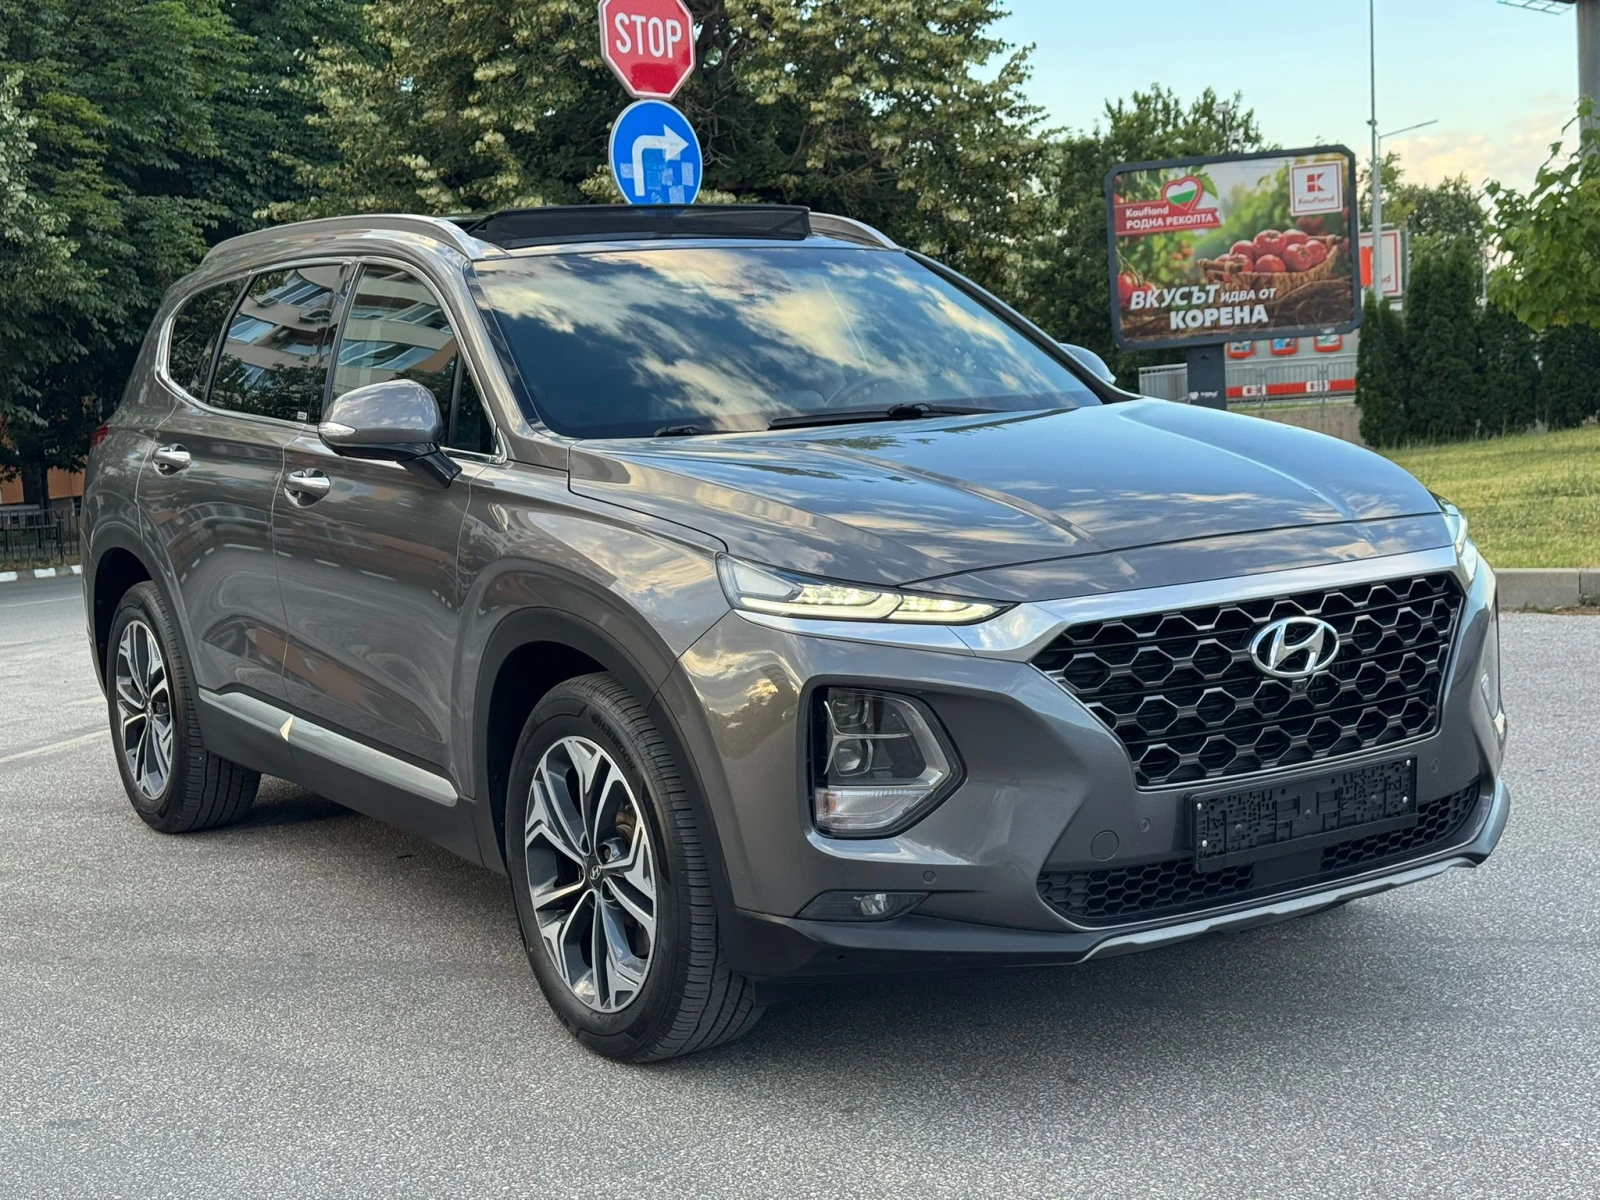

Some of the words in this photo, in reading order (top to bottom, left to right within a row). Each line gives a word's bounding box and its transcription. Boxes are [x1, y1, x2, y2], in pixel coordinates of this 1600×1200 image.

[614, 12, 682, 59] STOP
[1125, 205, 1169, 218] Kaufland
[1126, 217, 1165, 230] РОДНА
[1165, 212, 1214, 226] РЕКОЛТА
[1130, 284, 1220, 310] ВКУСЪТ
[1220, 290, 1256, 304] ИДВА
[1258, 287, 1277, 300] ОТ
[1169, 303, 1269, 330] КОРЕНА
